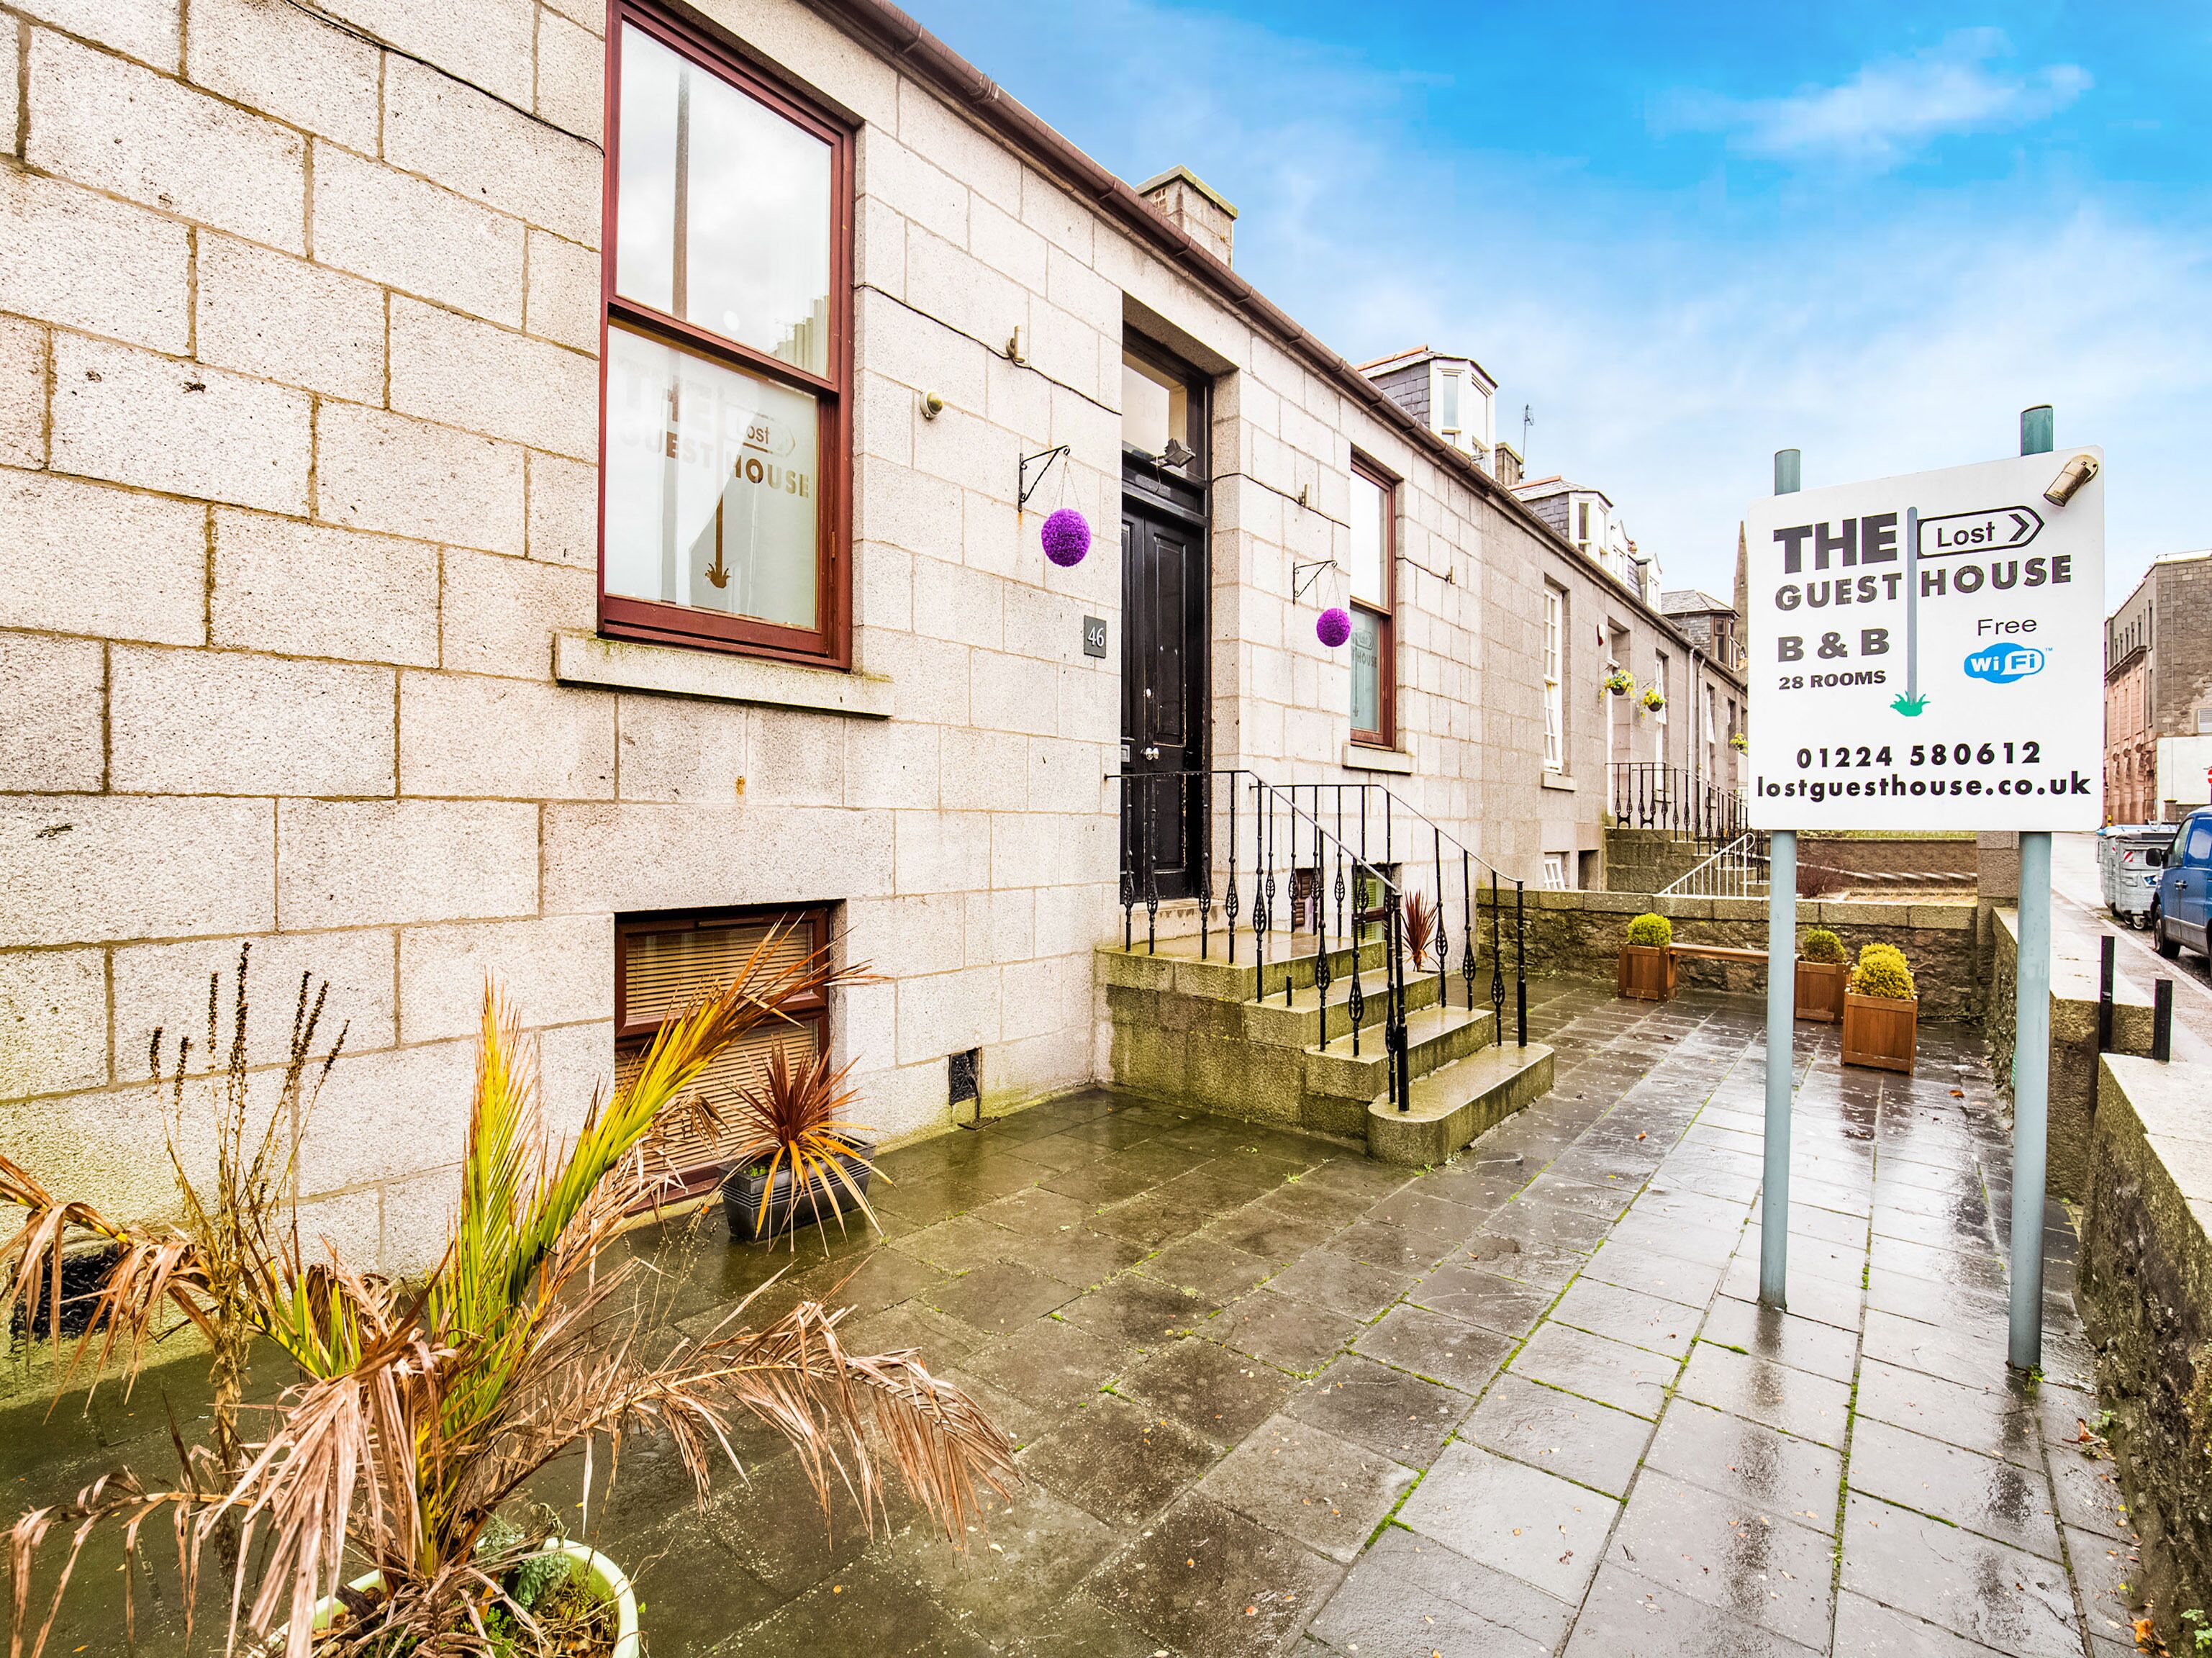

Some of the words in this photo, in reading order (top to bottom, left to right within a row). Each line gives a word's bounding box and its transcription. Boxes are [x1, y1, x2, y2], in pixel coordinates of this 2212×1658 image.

[726, 451, 809, 499] HOUSE
[1774, 512, 1898, 574] THE
[1936, 520, 1995, 548] Lost
[1775, 572, 1902, 611] GUEST
[1921, 554, 2072, 597] HOUSE
[1087, 627, 1105, 648] 46
[1977, 618, 2037, 636] Free
[1779, 636, 1804, 663] B
[1818, 632, 1848, 659] &
[1862, 628, 1890, 656] B
[1779, 676, 1804, 690] 28
[1810, 670, 1887, 688] ROOMS
[1797, 746, 1893, 769] 01224
[1910, 741, 2040, 766] 580612
[1758, 771, 2091, 803] lostguesthouse.co.uk
